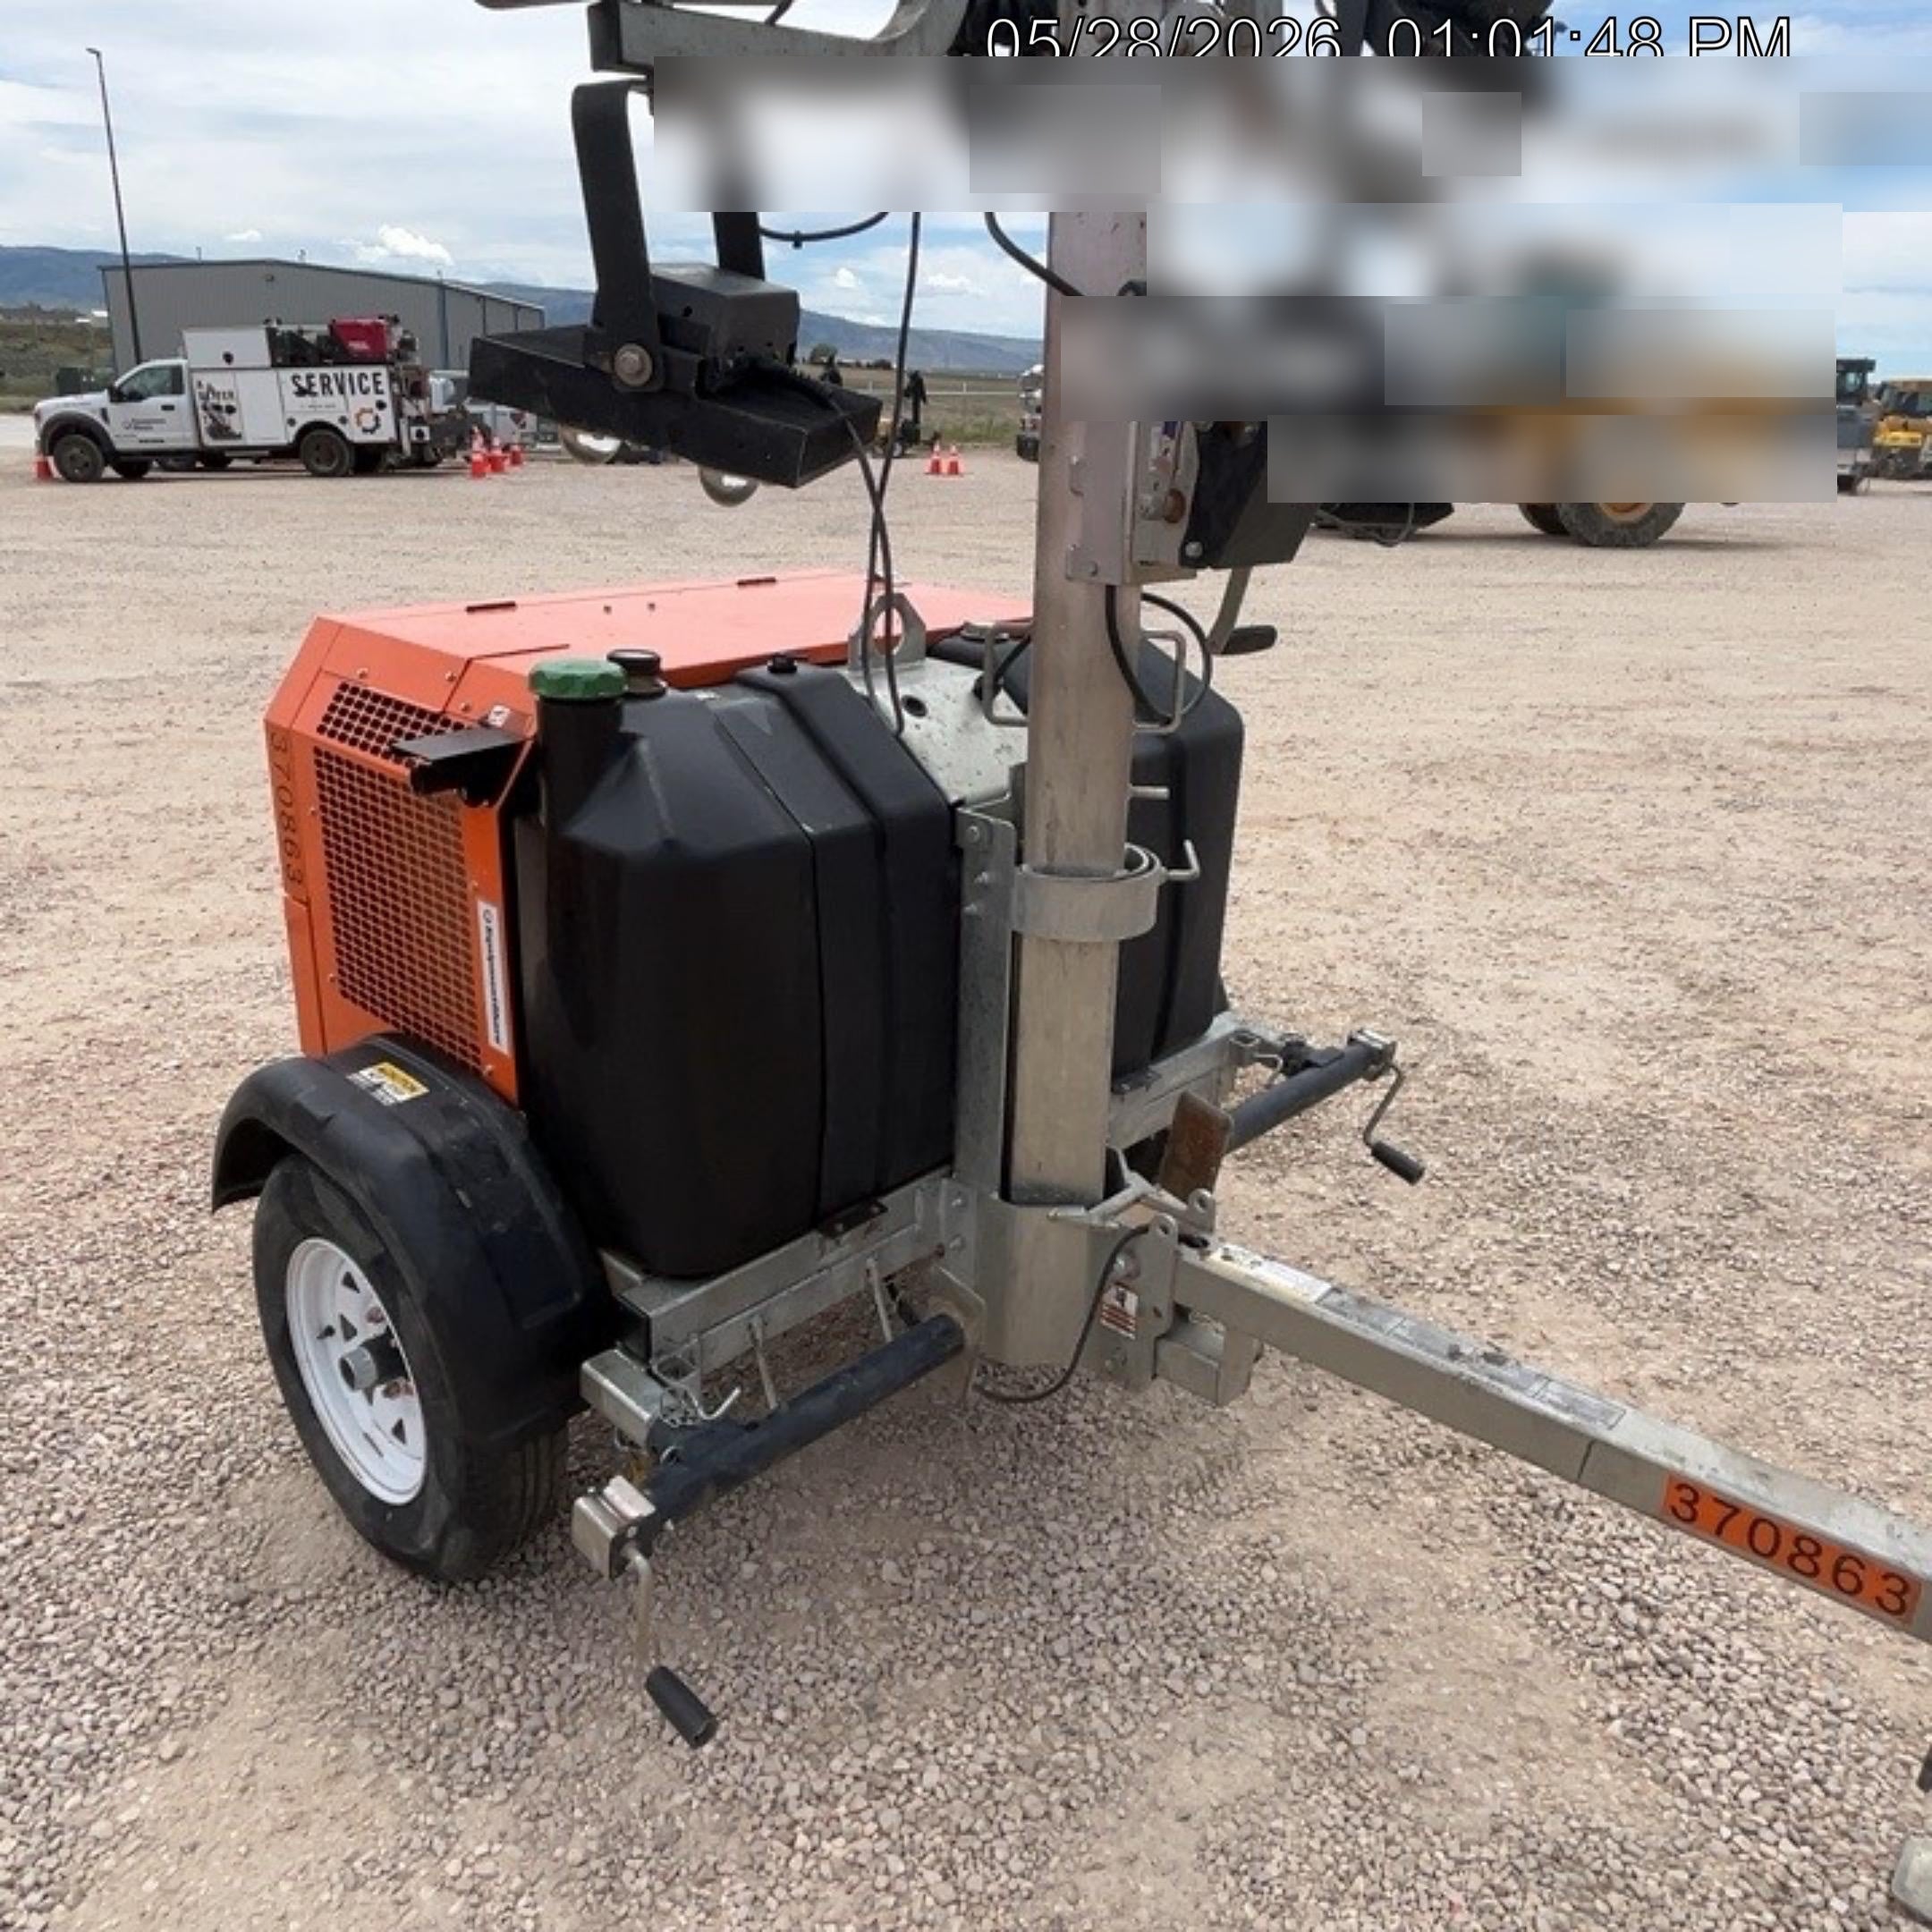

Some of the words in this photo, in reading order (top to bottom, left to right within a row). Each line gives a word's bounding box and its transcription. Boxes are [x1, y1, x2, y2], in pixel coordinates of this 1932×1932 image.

[291, 370, 386, 397] SERVICE
[270, 731, 304, 886] 370863
[1670, 1482, 1912, 1616] 370863
